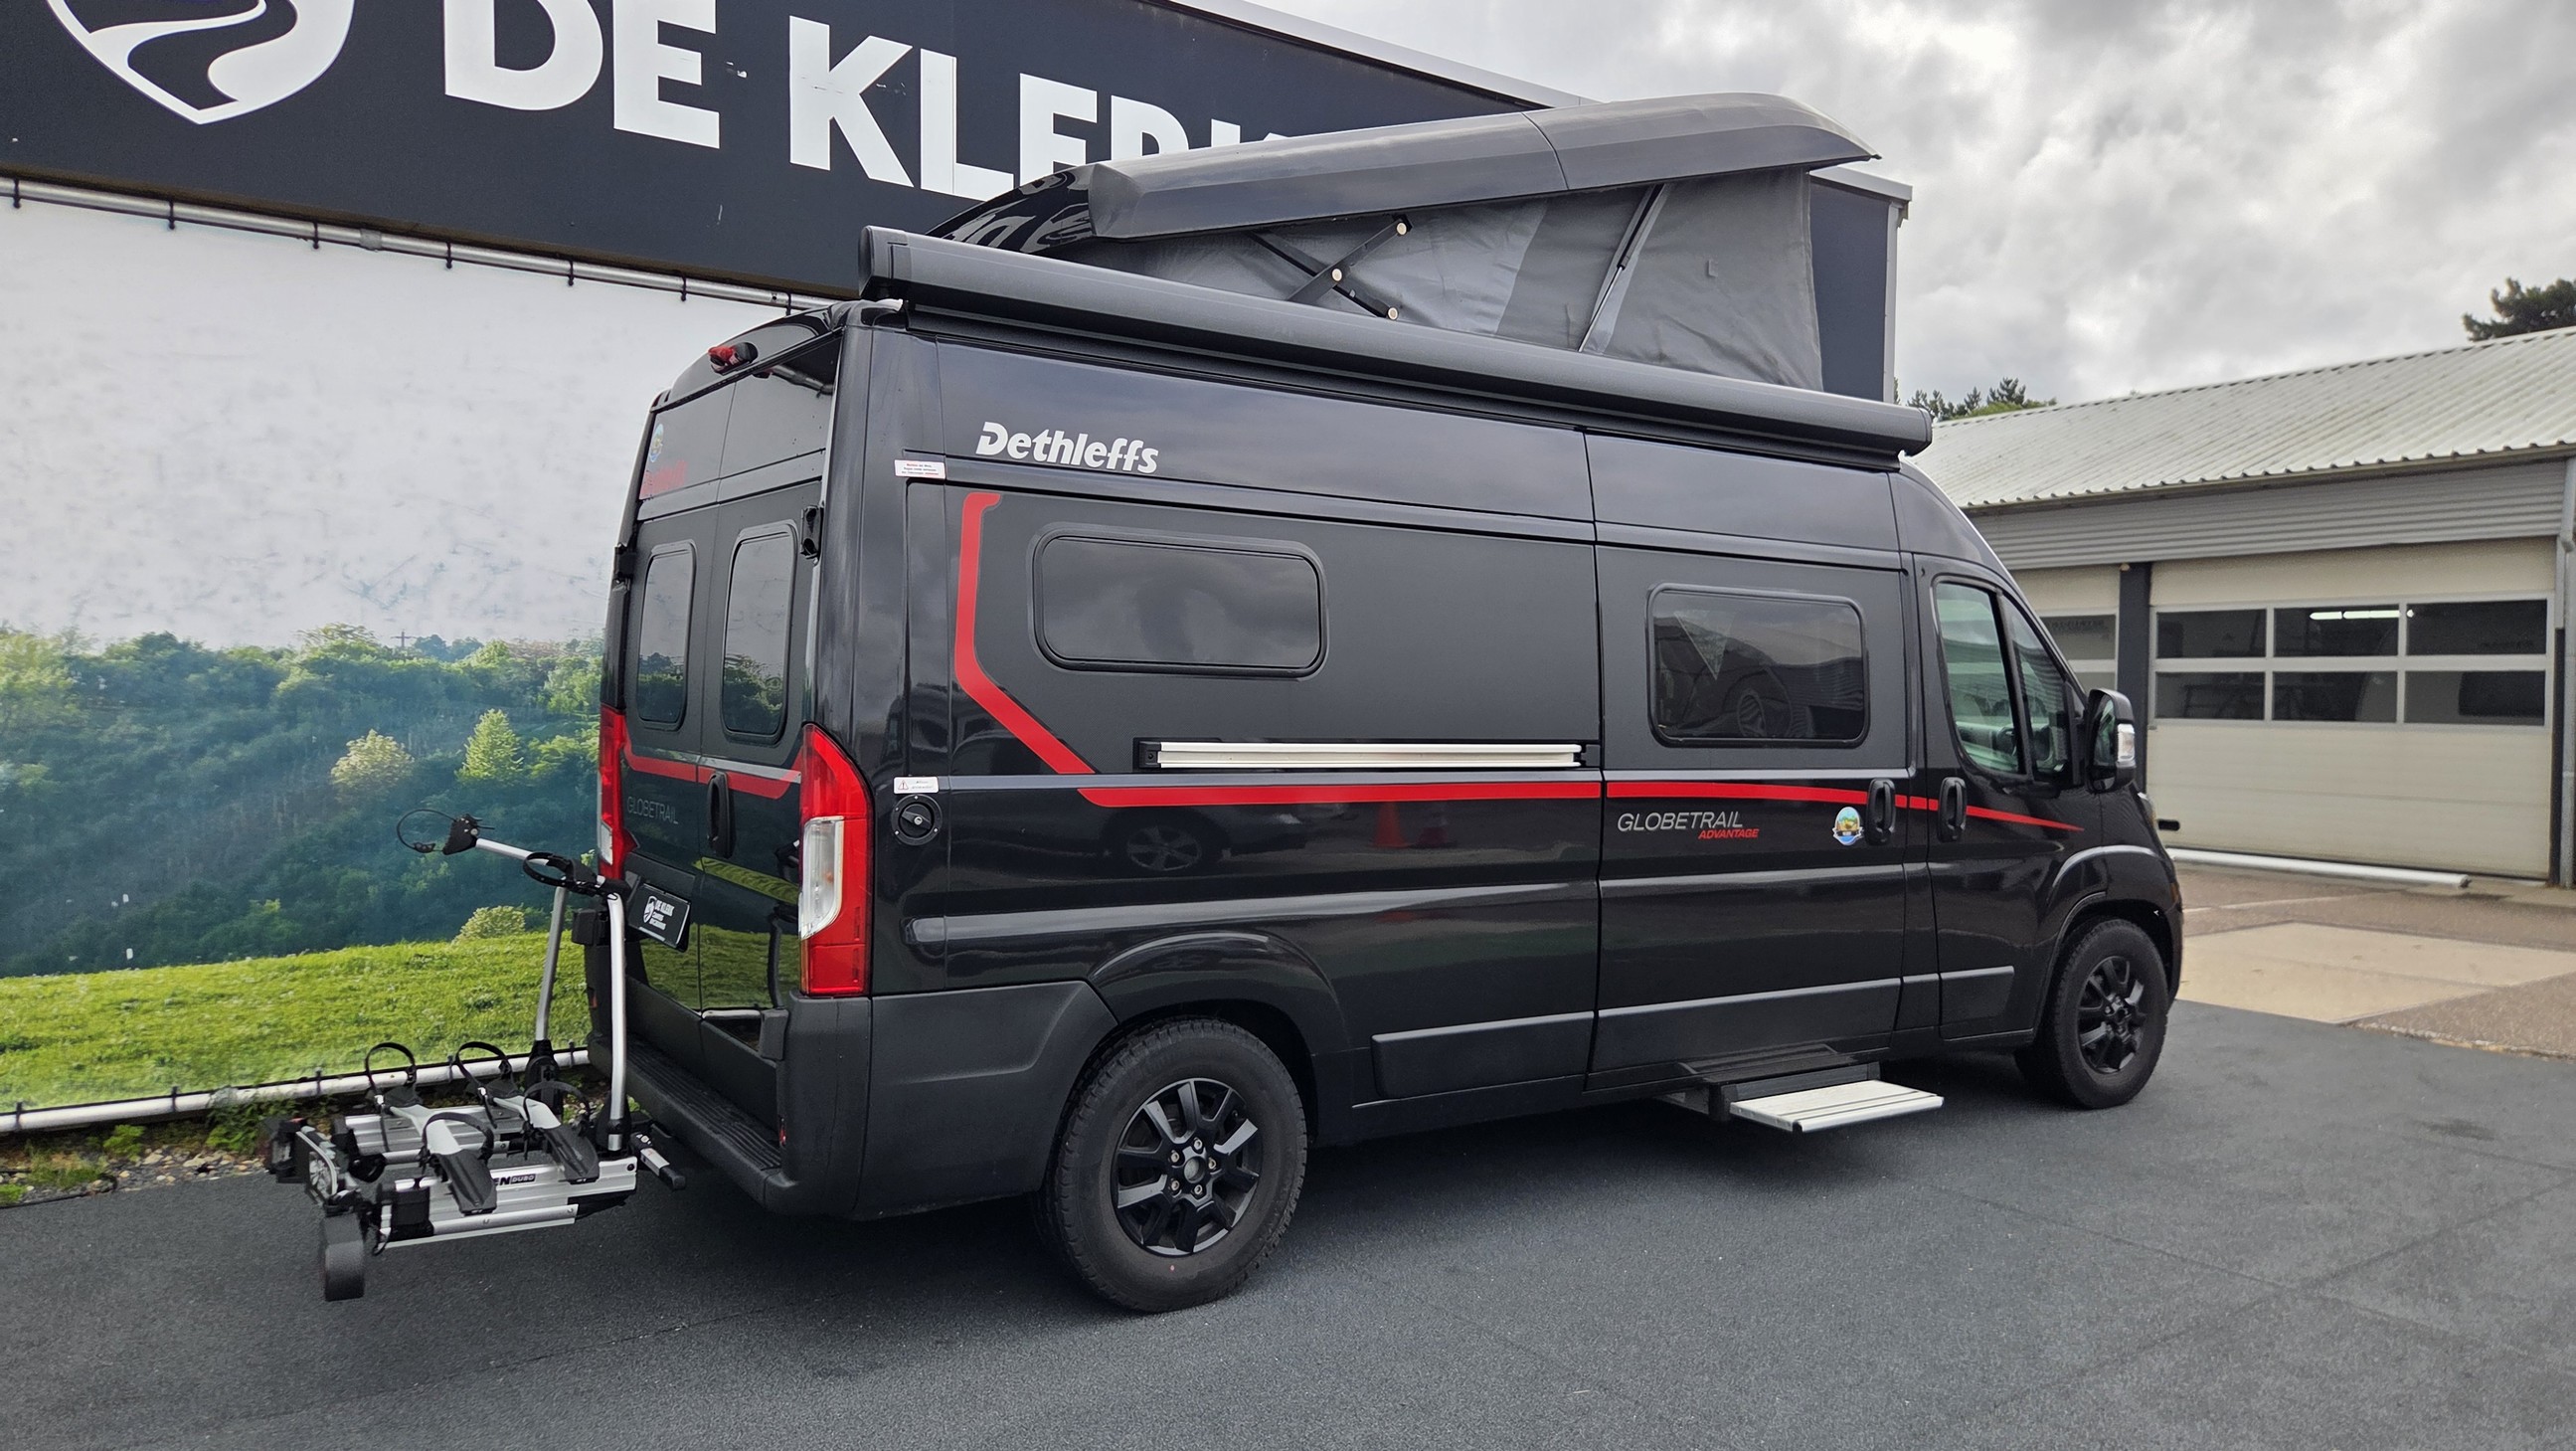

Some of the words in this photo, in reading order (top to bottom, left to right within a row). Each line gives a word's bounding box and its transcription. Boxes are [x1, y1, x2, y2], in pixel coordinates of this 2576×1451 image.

[443, 0, 721, 149] DE
[789, 15, 1288, 203] KLE
[975, 421, 1159, 474] Dethleffs
[626, 796, 679, 824] GLOBETRAIL
[1617, 811, 1744, 832] GLOBETRAIL
[1697, 828, 1760, 840] ADVANTAGE
